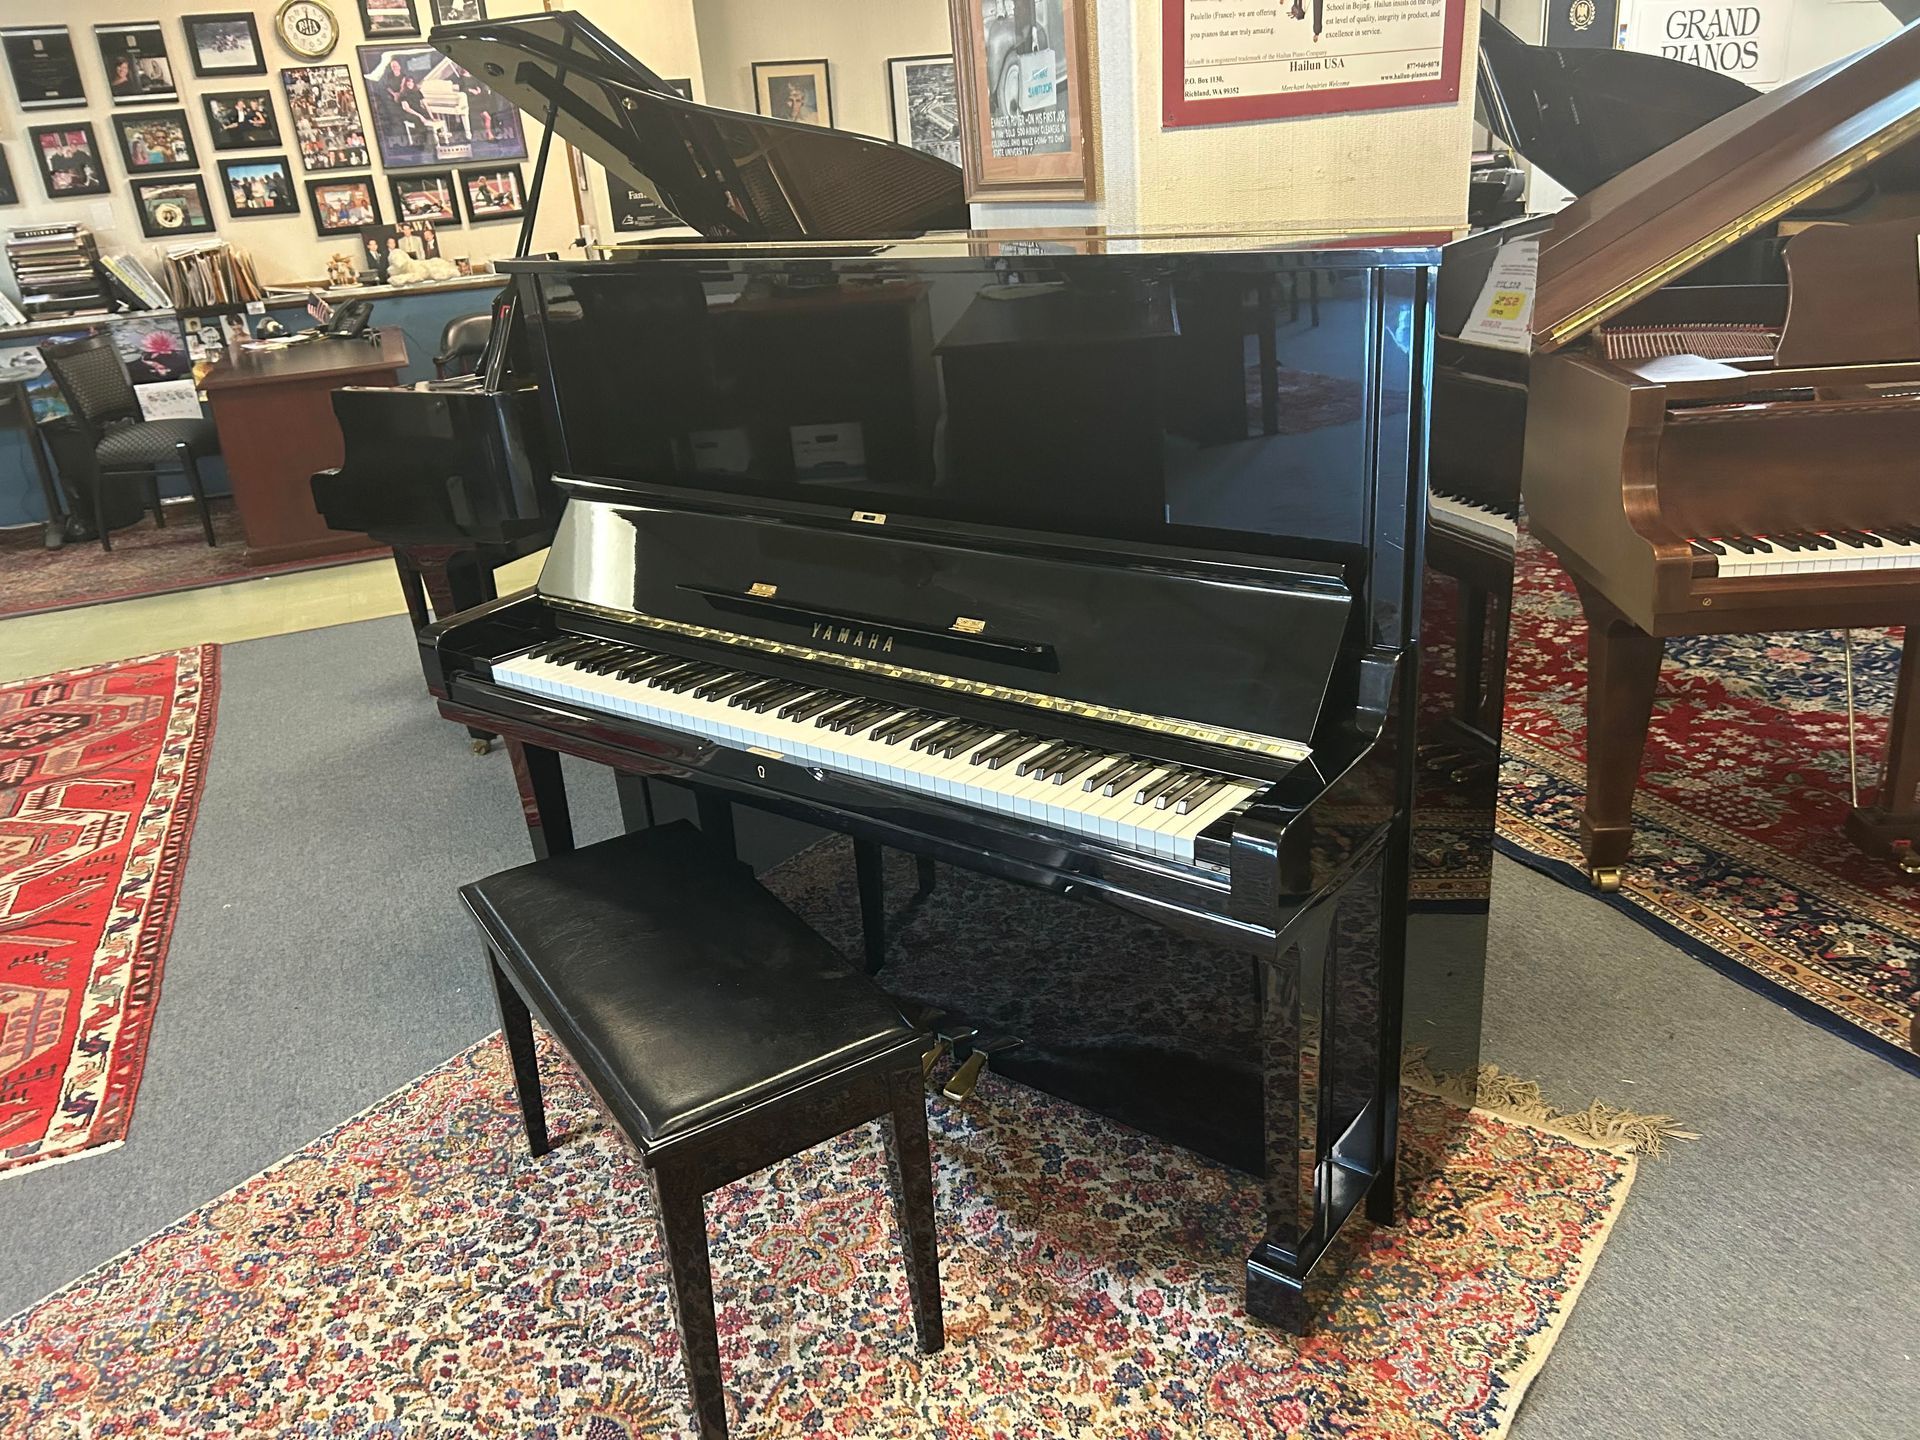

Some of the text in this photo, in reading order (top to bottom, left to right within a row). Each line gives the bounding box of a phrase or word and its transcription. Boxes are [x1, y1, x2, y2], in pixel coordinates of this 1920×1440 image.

[1326, 3, 1345, 11] School
[1374, 0, 1392, 8] Hailun
[1256, 9, 1276, 17] offering
[1335, 16, 1348, 24] level
[1349, 15, 1356, 23] of
[1378, 13, 1399, 22] integrity
[1666, 7, 1760, 41] GRAND
[1239, 28, 1251, 36] truly
[1326, 30, 1353, 38] excellence
[1290, 58, 1345, 72] Hailun USA
[1281, 80, 1350, 92] Merchant Inquiries Welcome
[1184, 90, 1211, 98] Richland,
[1043, 111, 1056, 123] FIRST
[811, 622, 893, 652] YAMAHA
